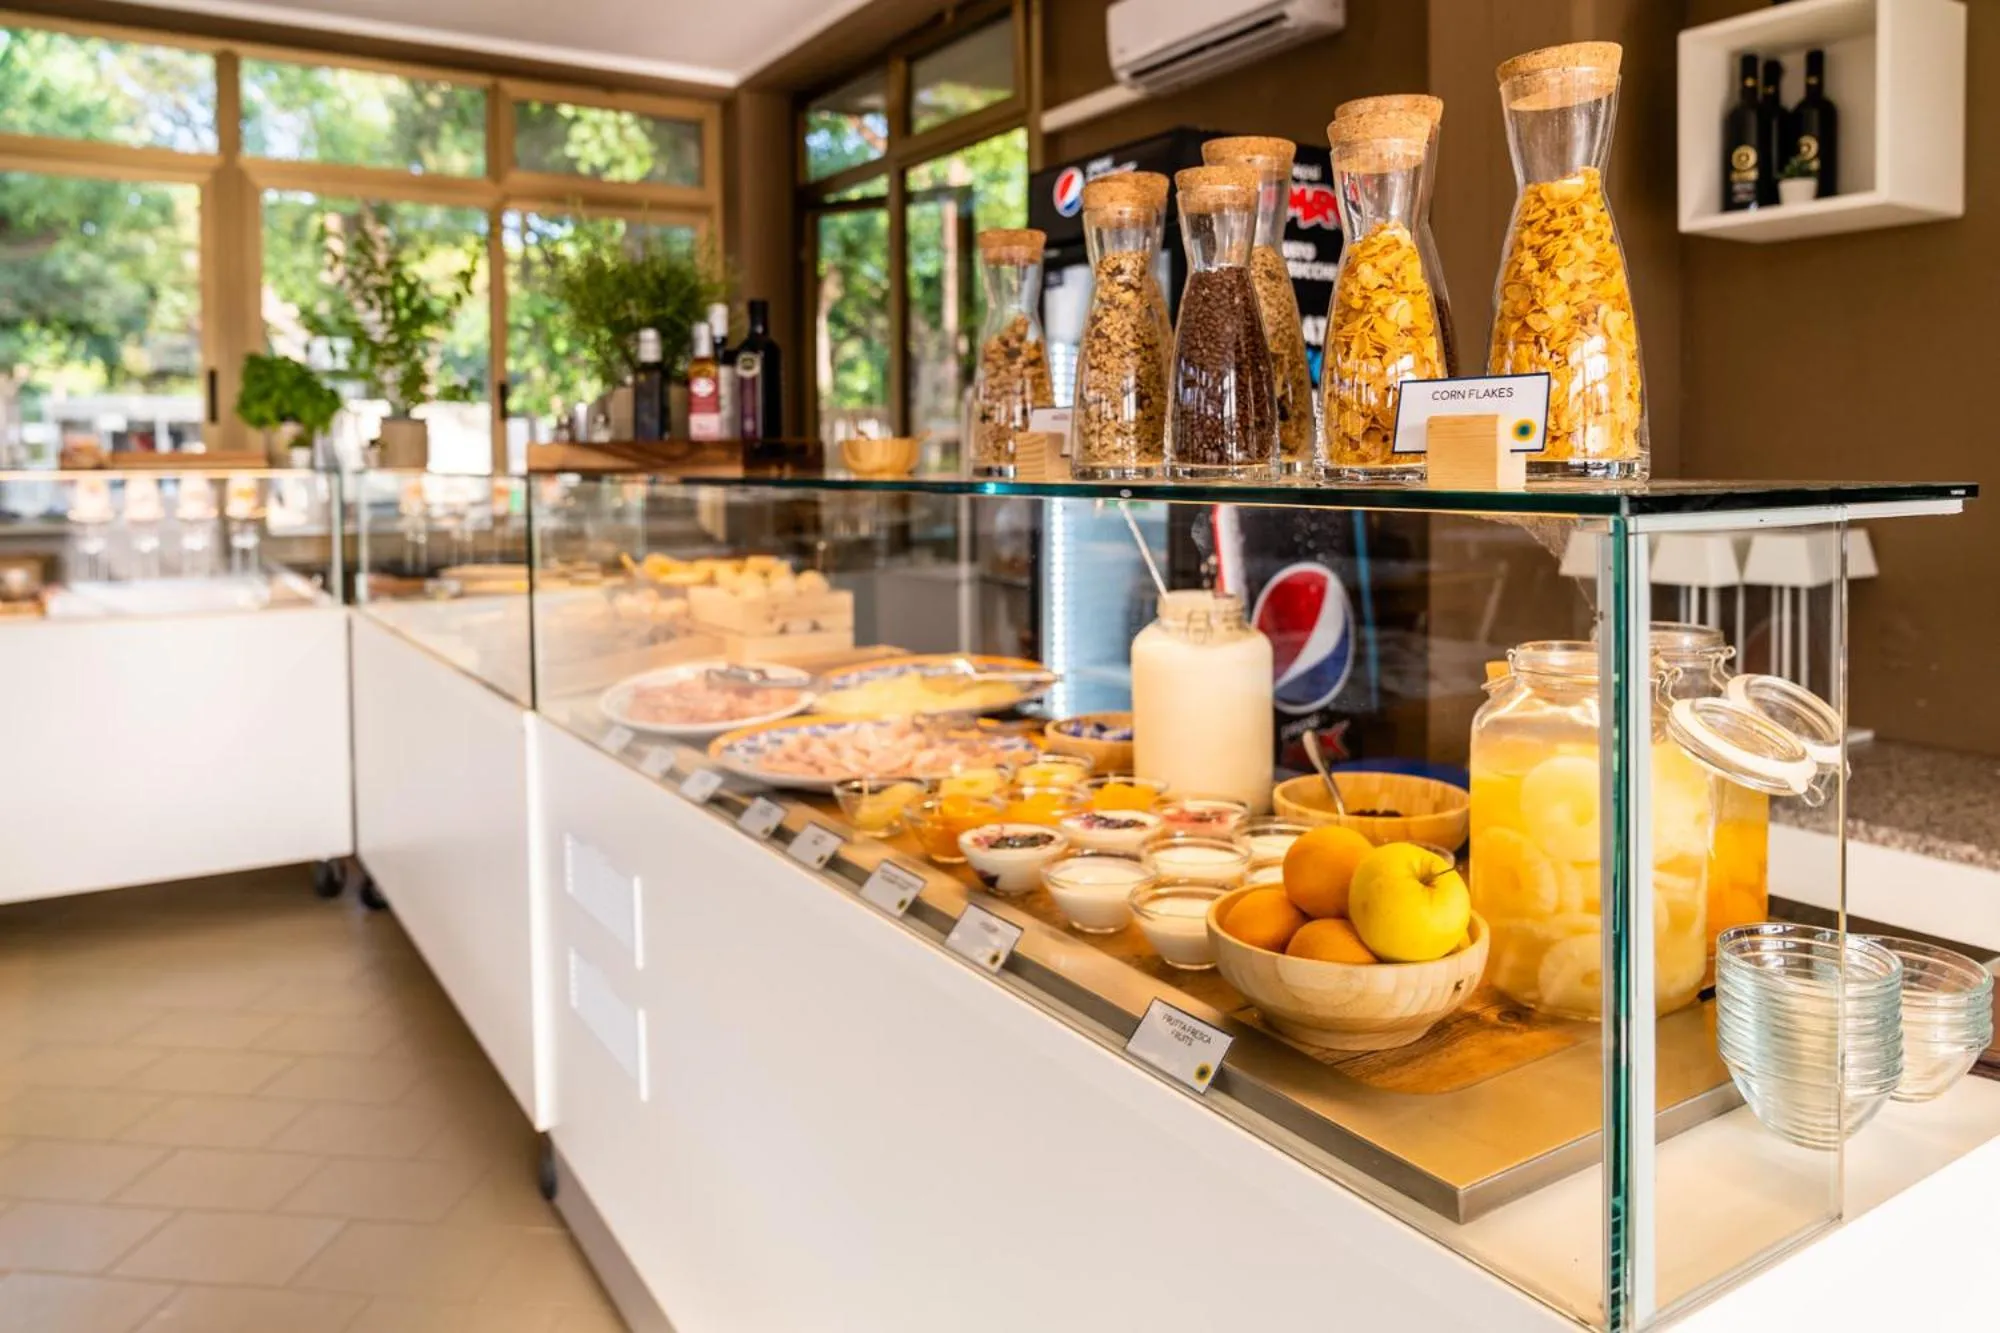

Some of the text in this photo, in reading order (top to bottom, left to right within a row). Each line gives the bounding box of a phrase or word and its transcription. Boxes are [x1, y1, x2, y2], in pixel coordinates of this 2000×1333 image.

[1431, 386, 1514, 401] CORN FLAKES
[1162, 1013, 1212, 1045] FRUTTA FRESCA
